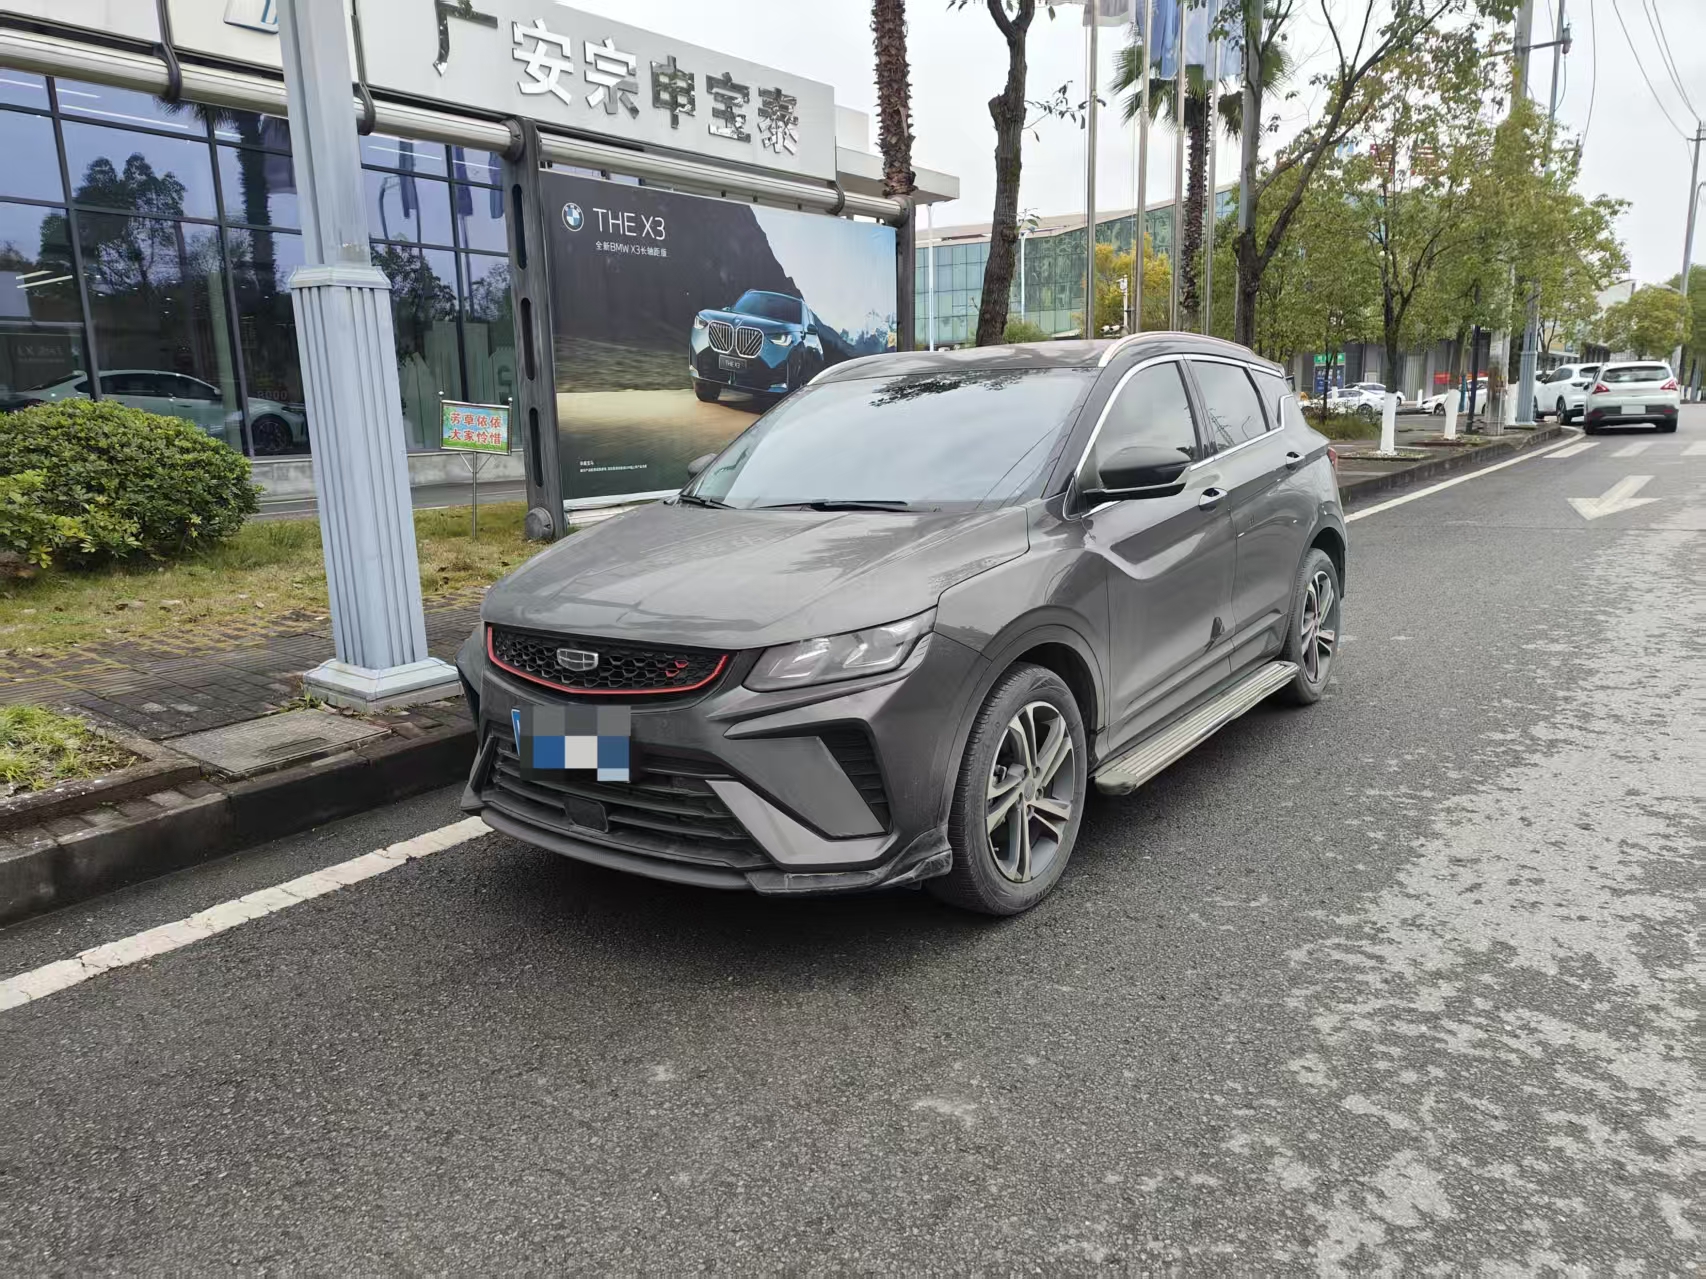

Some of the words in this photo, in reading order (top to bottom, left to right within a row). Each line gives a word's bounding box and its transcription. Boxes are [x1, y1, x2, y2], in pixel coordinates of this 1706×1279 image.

[433, 0, 800, 155] 广安宗申宝泰
[592, 207, 637, 236] THE
[641, 214, 666, 240] X3
[595, 240, 629, 253] 全新BMW
[450, 411, 502, 429] 芳草依依
[450, 428, 502, 445] 大家怜惜
